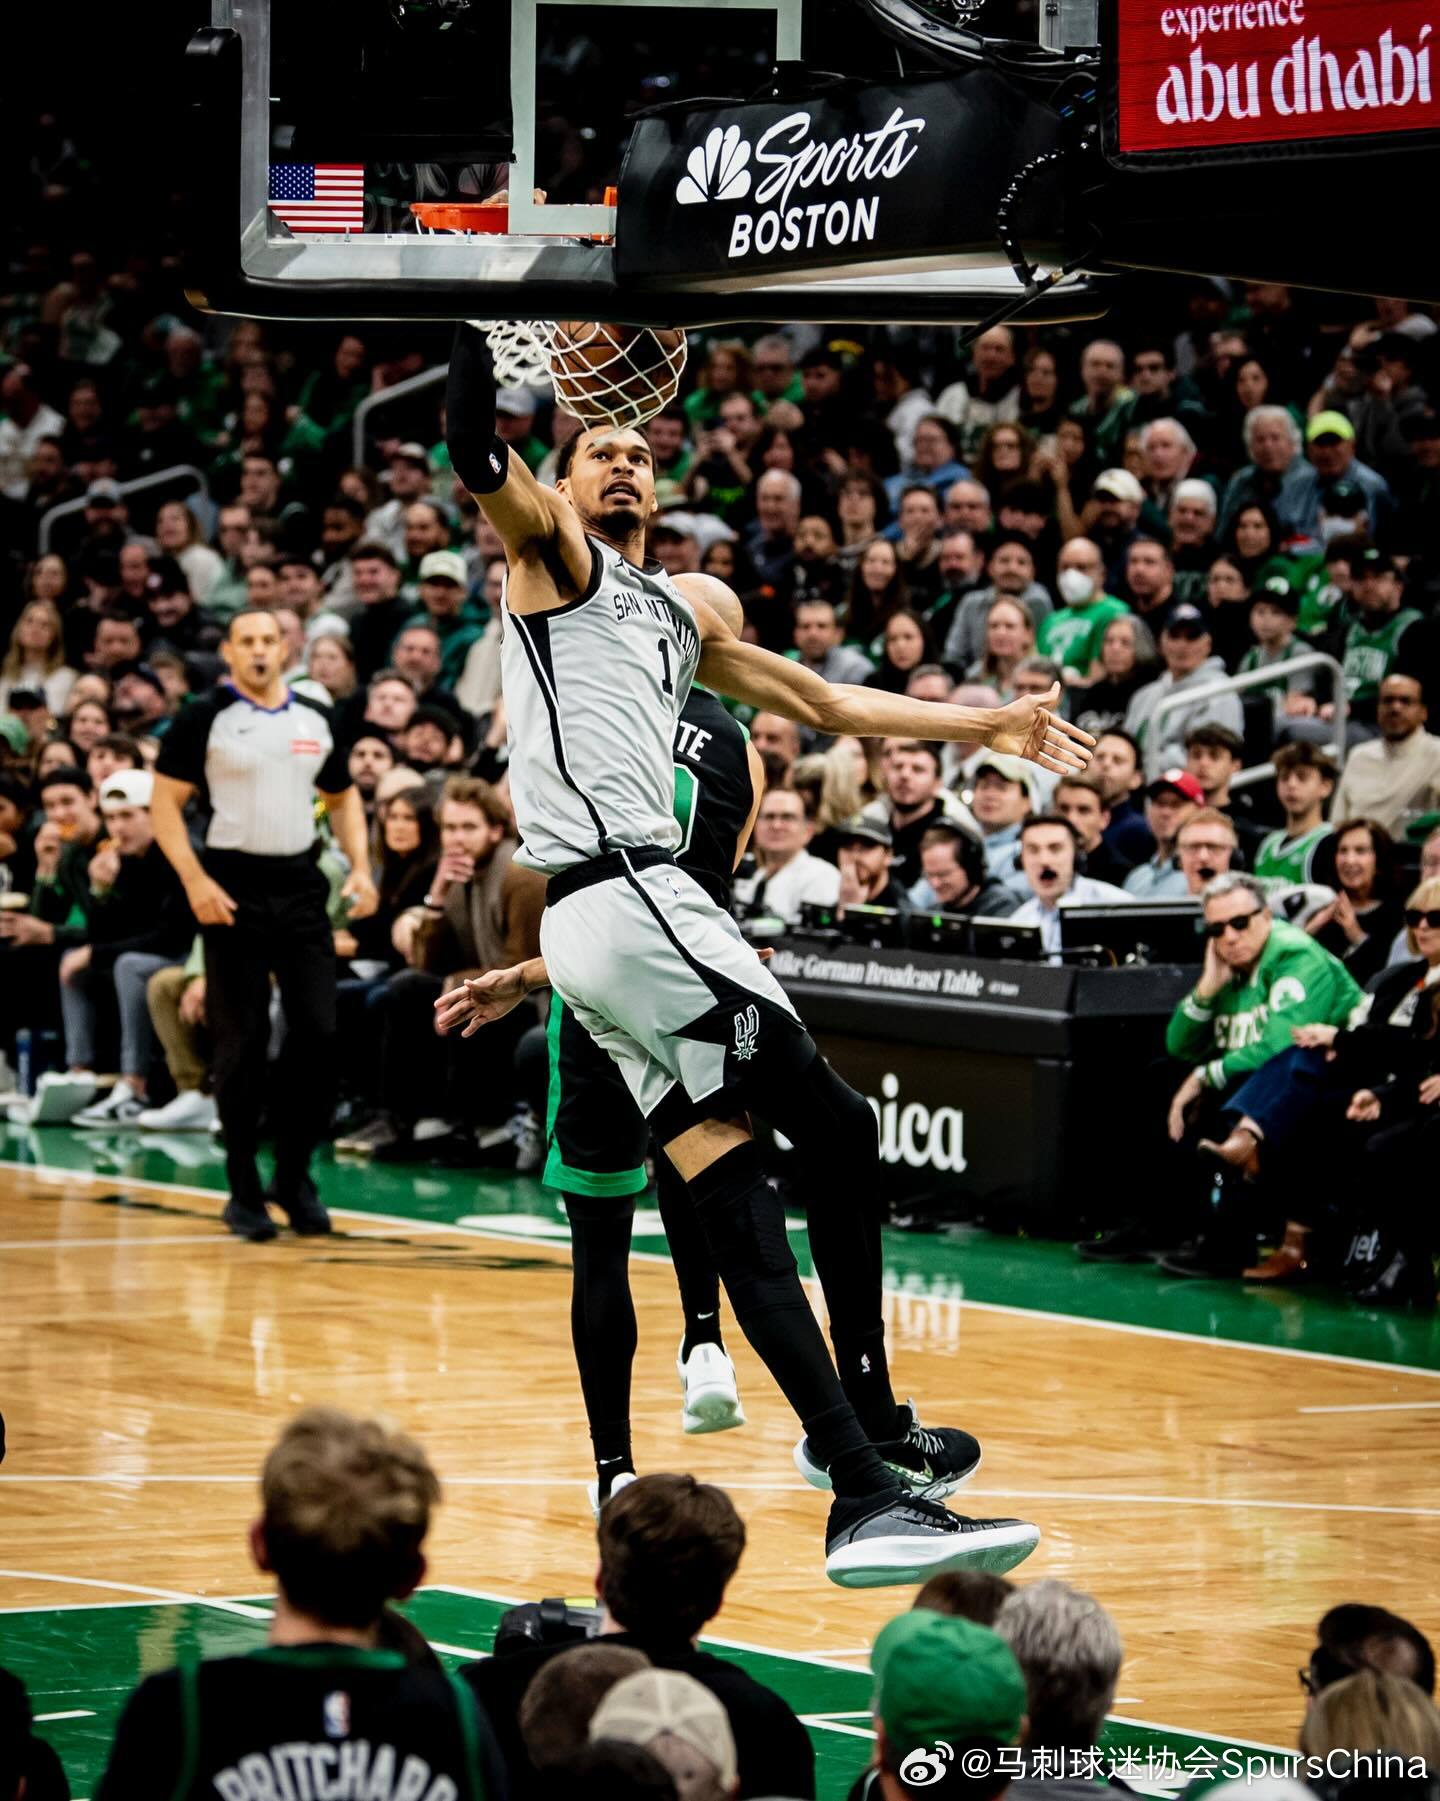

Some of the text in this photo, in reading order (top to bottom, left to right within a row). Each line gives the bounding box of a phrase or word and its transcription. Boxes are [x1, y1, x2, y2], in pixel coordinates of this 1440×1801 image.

[1160, 0, 1305, 43] experience
[1156, 45, 1261, 125] abu
[755, 106, 926, 217] Sports
[727, 196, 880, 258] BOSTON
[613, 591, 643, 621] SAN
[657, 637, 674, 697] 1
[803, 954, 865, 984] Gorman
[864, 960, 942, 992] Broadcast
[942, 968, 984, 997] Table
